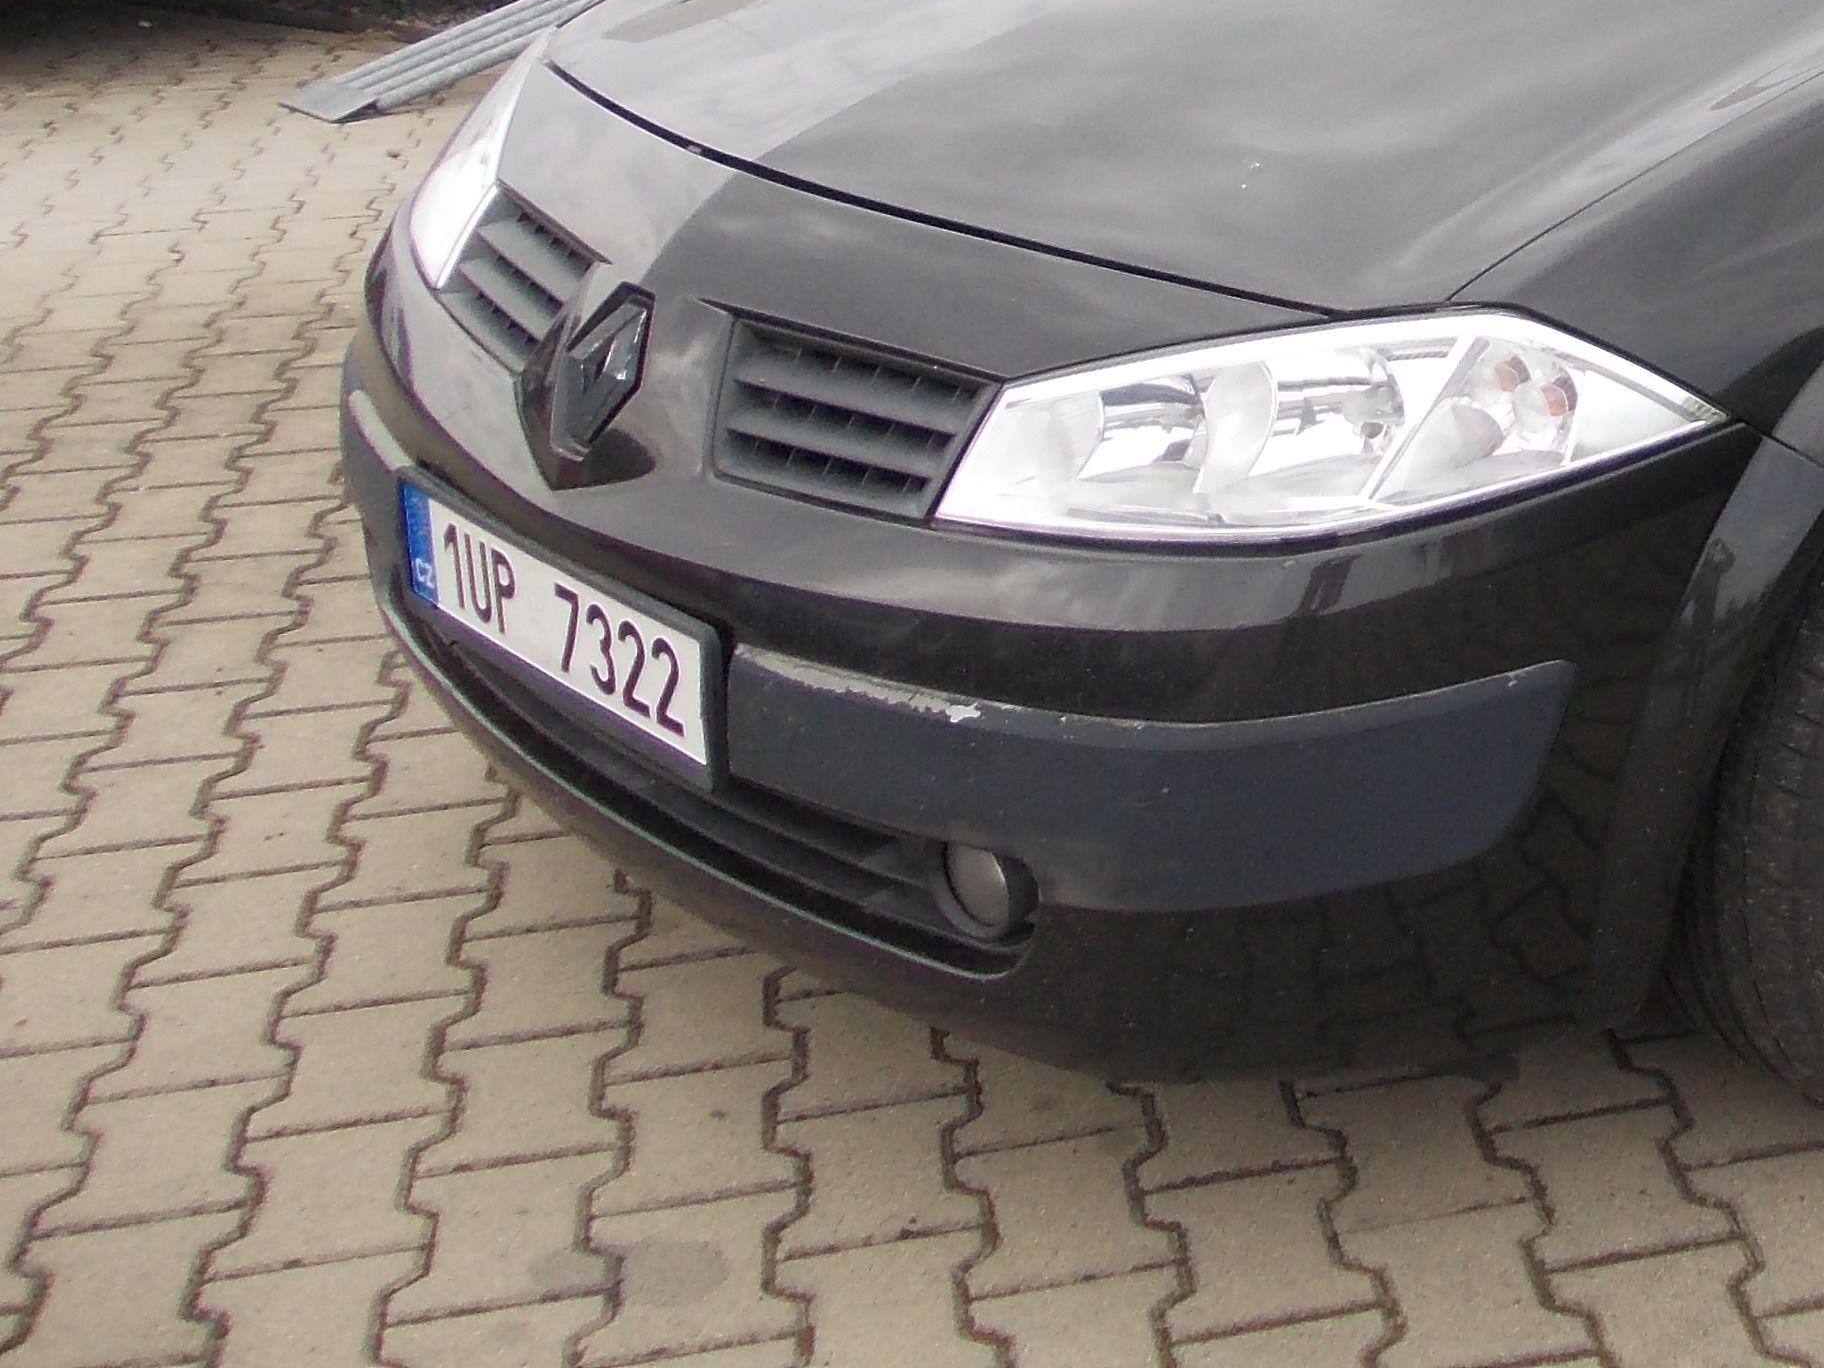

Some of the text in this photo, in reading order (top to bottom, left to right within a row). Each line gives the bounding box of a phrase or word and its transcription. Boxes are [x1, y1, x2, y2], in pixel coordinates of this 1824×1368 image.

[415, 557, 435, 589] CZ
[443, 522, 686, 737] 1UP 7322
